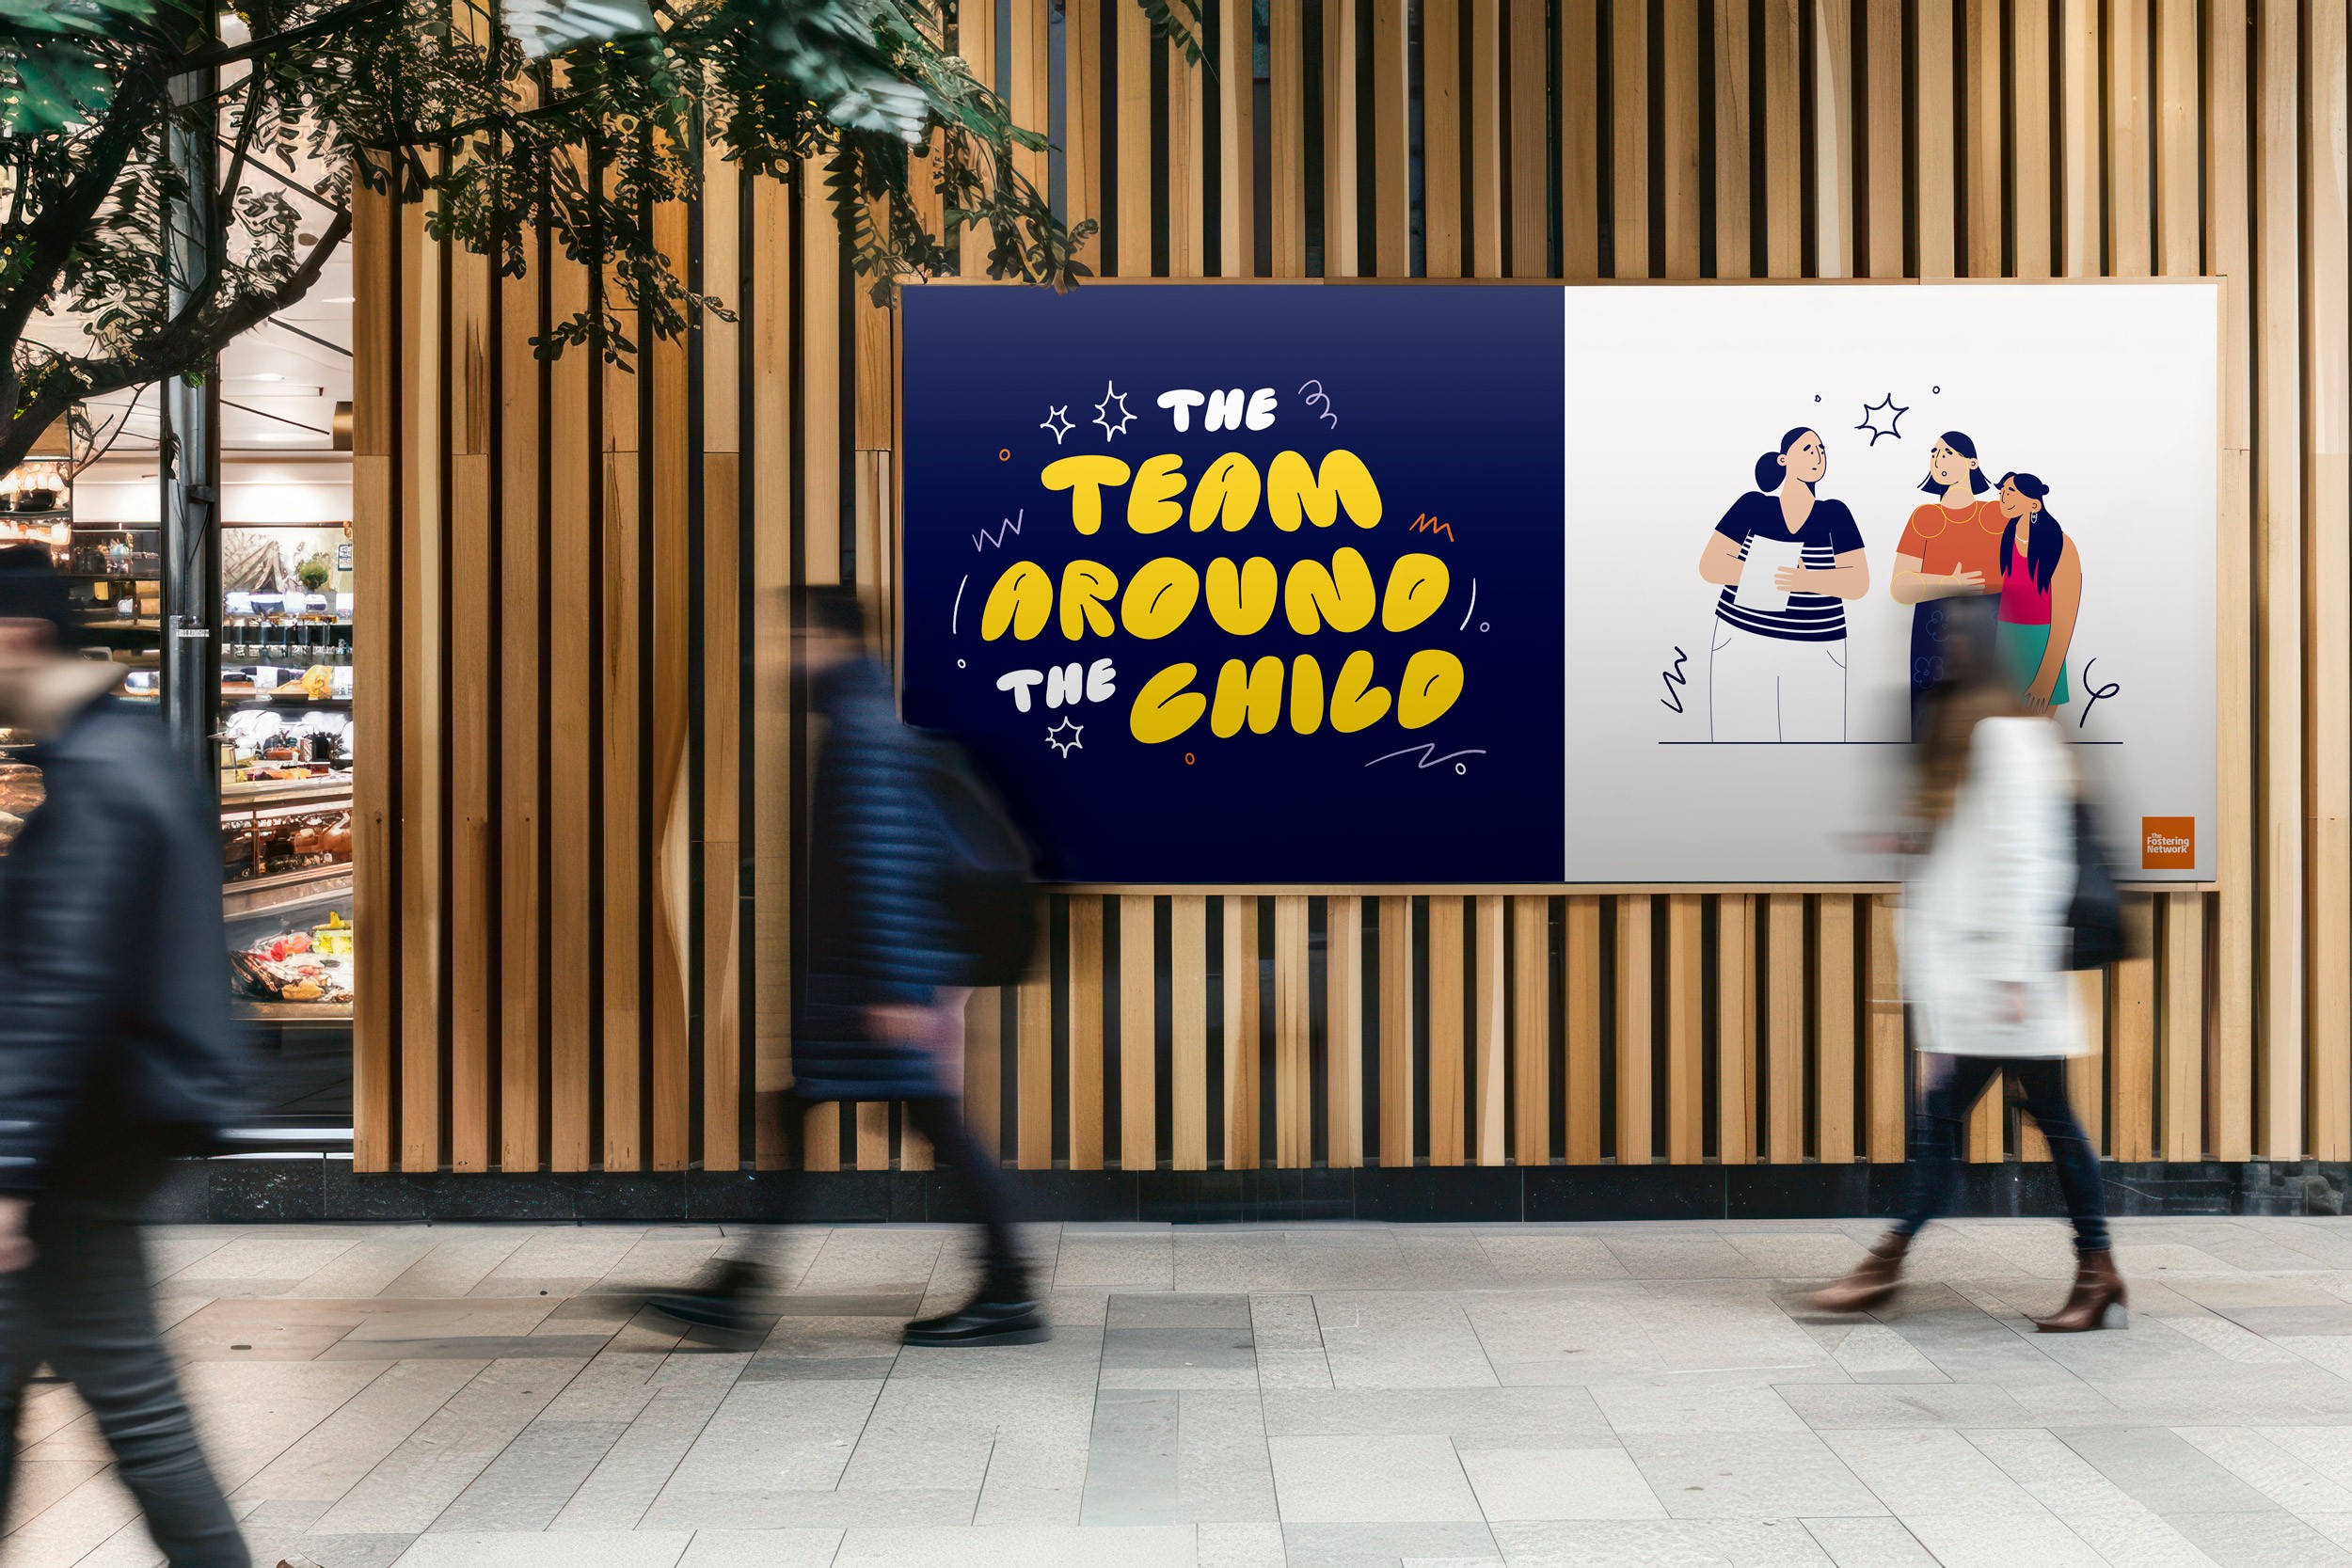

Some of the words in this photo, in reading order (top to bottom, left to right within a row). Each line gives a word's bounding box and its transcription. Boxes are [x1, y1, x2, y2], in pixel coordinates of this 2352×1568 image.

[1157, 388, 1278, 432] THE
[1041, 450, 1383, 535] TEAM
[981, 546, 1450, 641] AROUND
[996, 658, 1117, 713] THE
[1129, 649, 1465, 744] CHILD
[2147, 836, 2189, 847] Fostering
